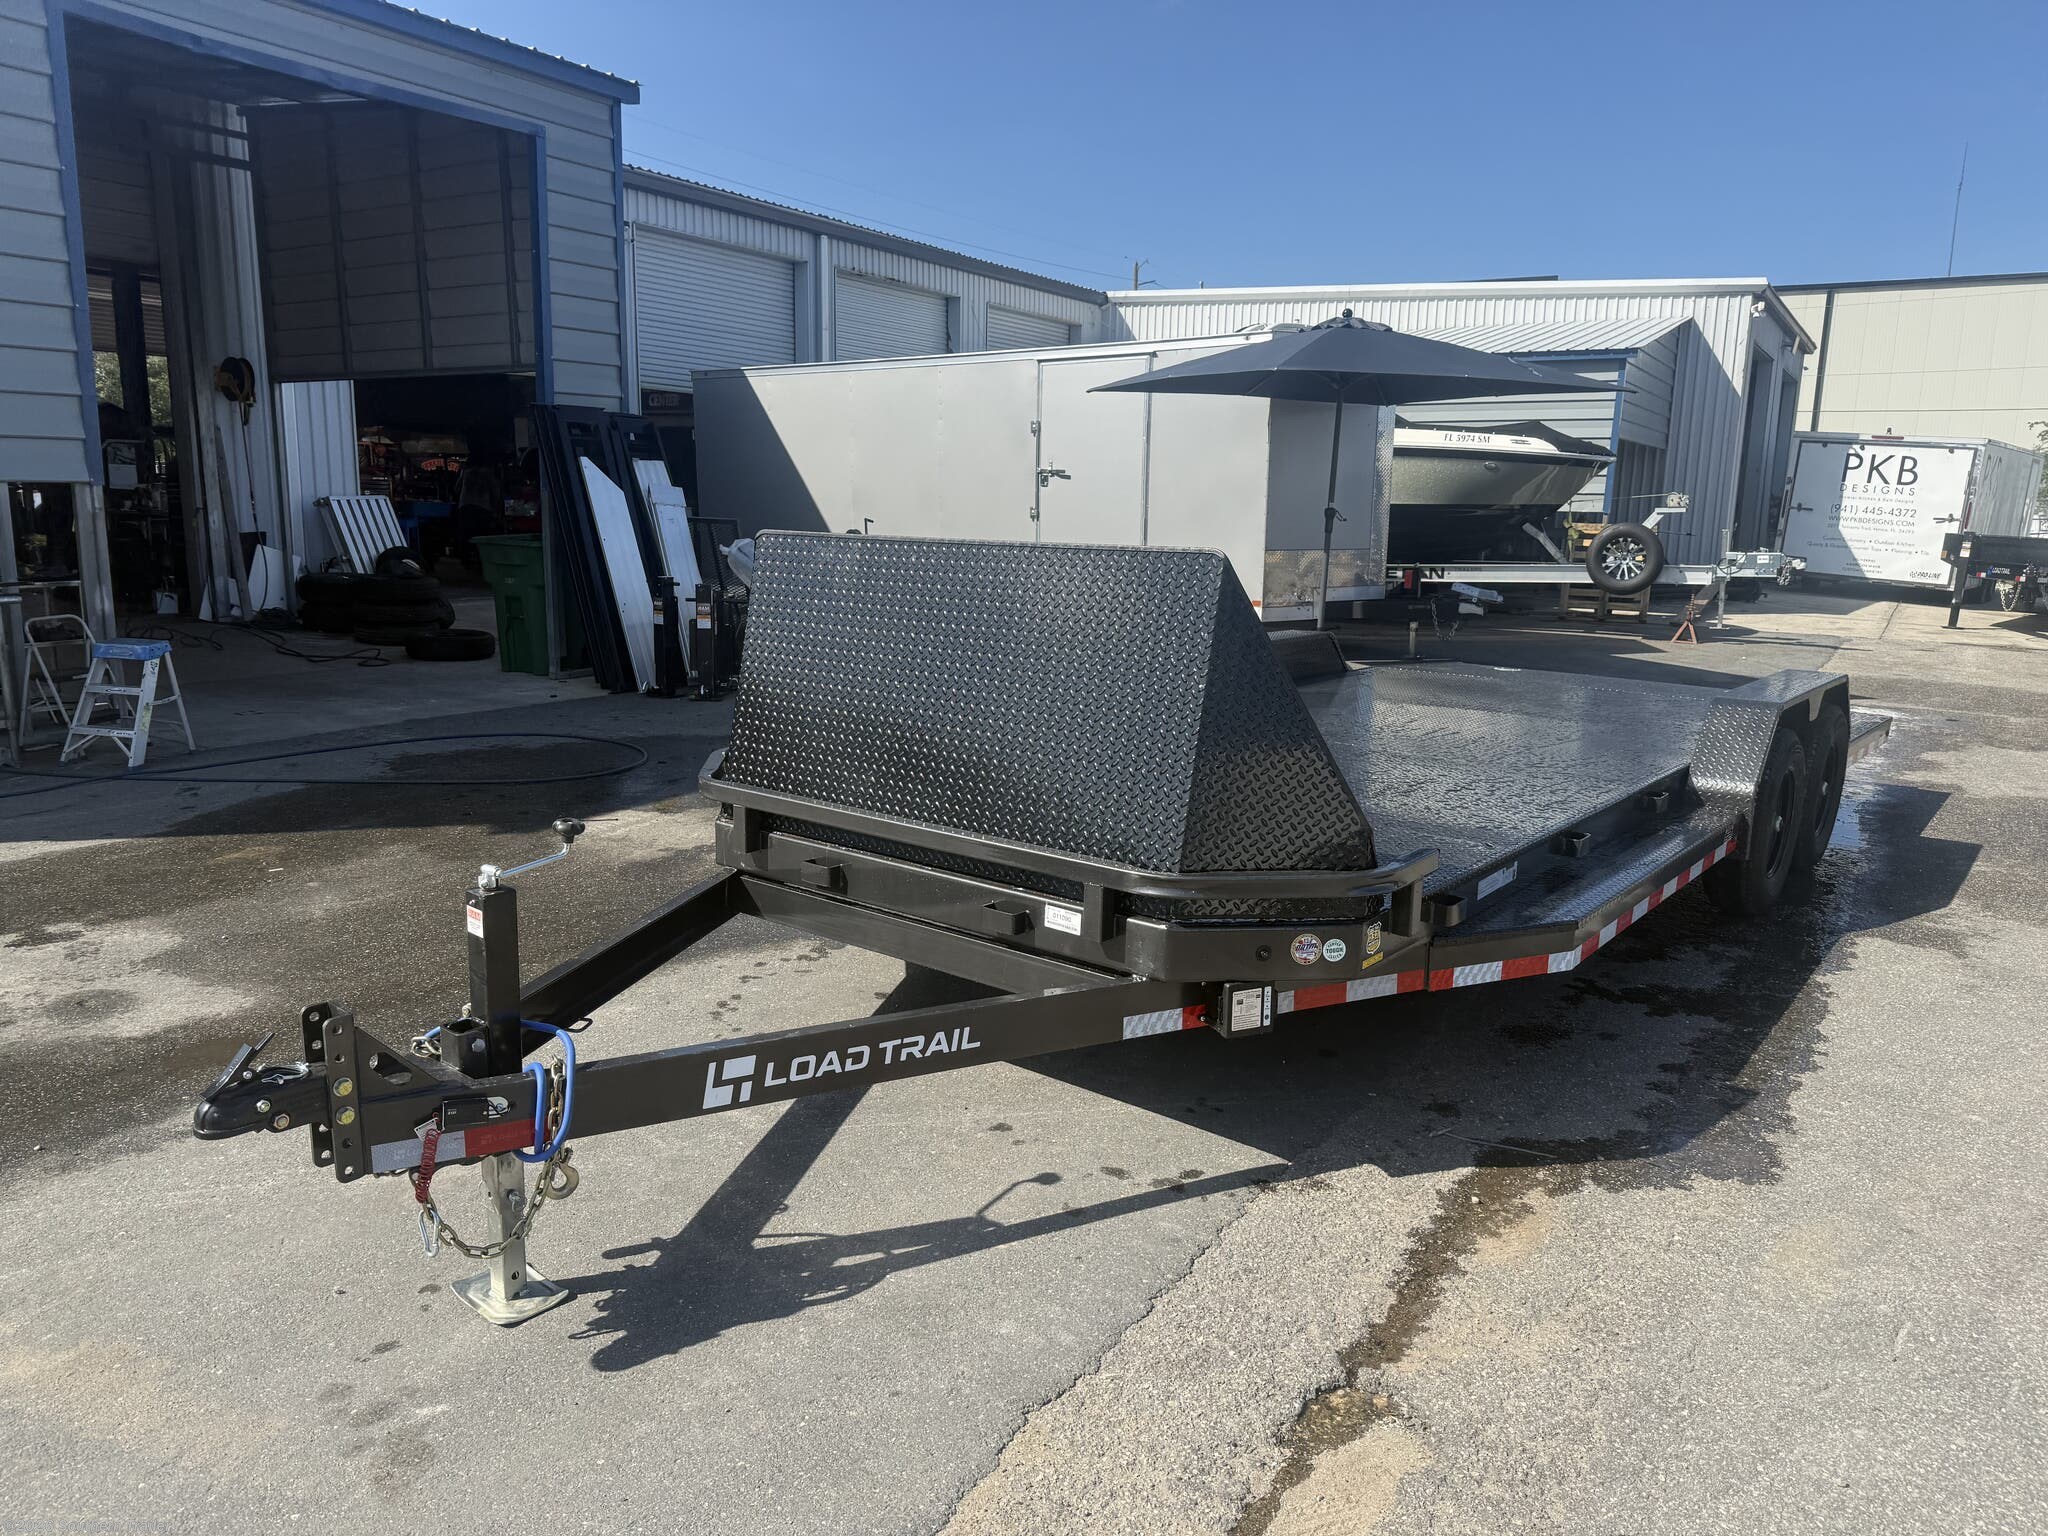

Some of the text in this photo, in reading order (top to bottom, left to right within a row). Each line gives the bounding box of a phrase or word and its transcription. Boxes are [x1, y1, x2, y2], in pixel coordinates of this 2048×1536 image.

[1841, 452, 1919, 486] PKB
[1840, 483, 1916, 496] DESIGNS
[1830, 503, 1917, 519] (941) 445-4372
[764, 1045, 871, 1087] LOAD
[879, 1026, 981, 1065] TRAIL
